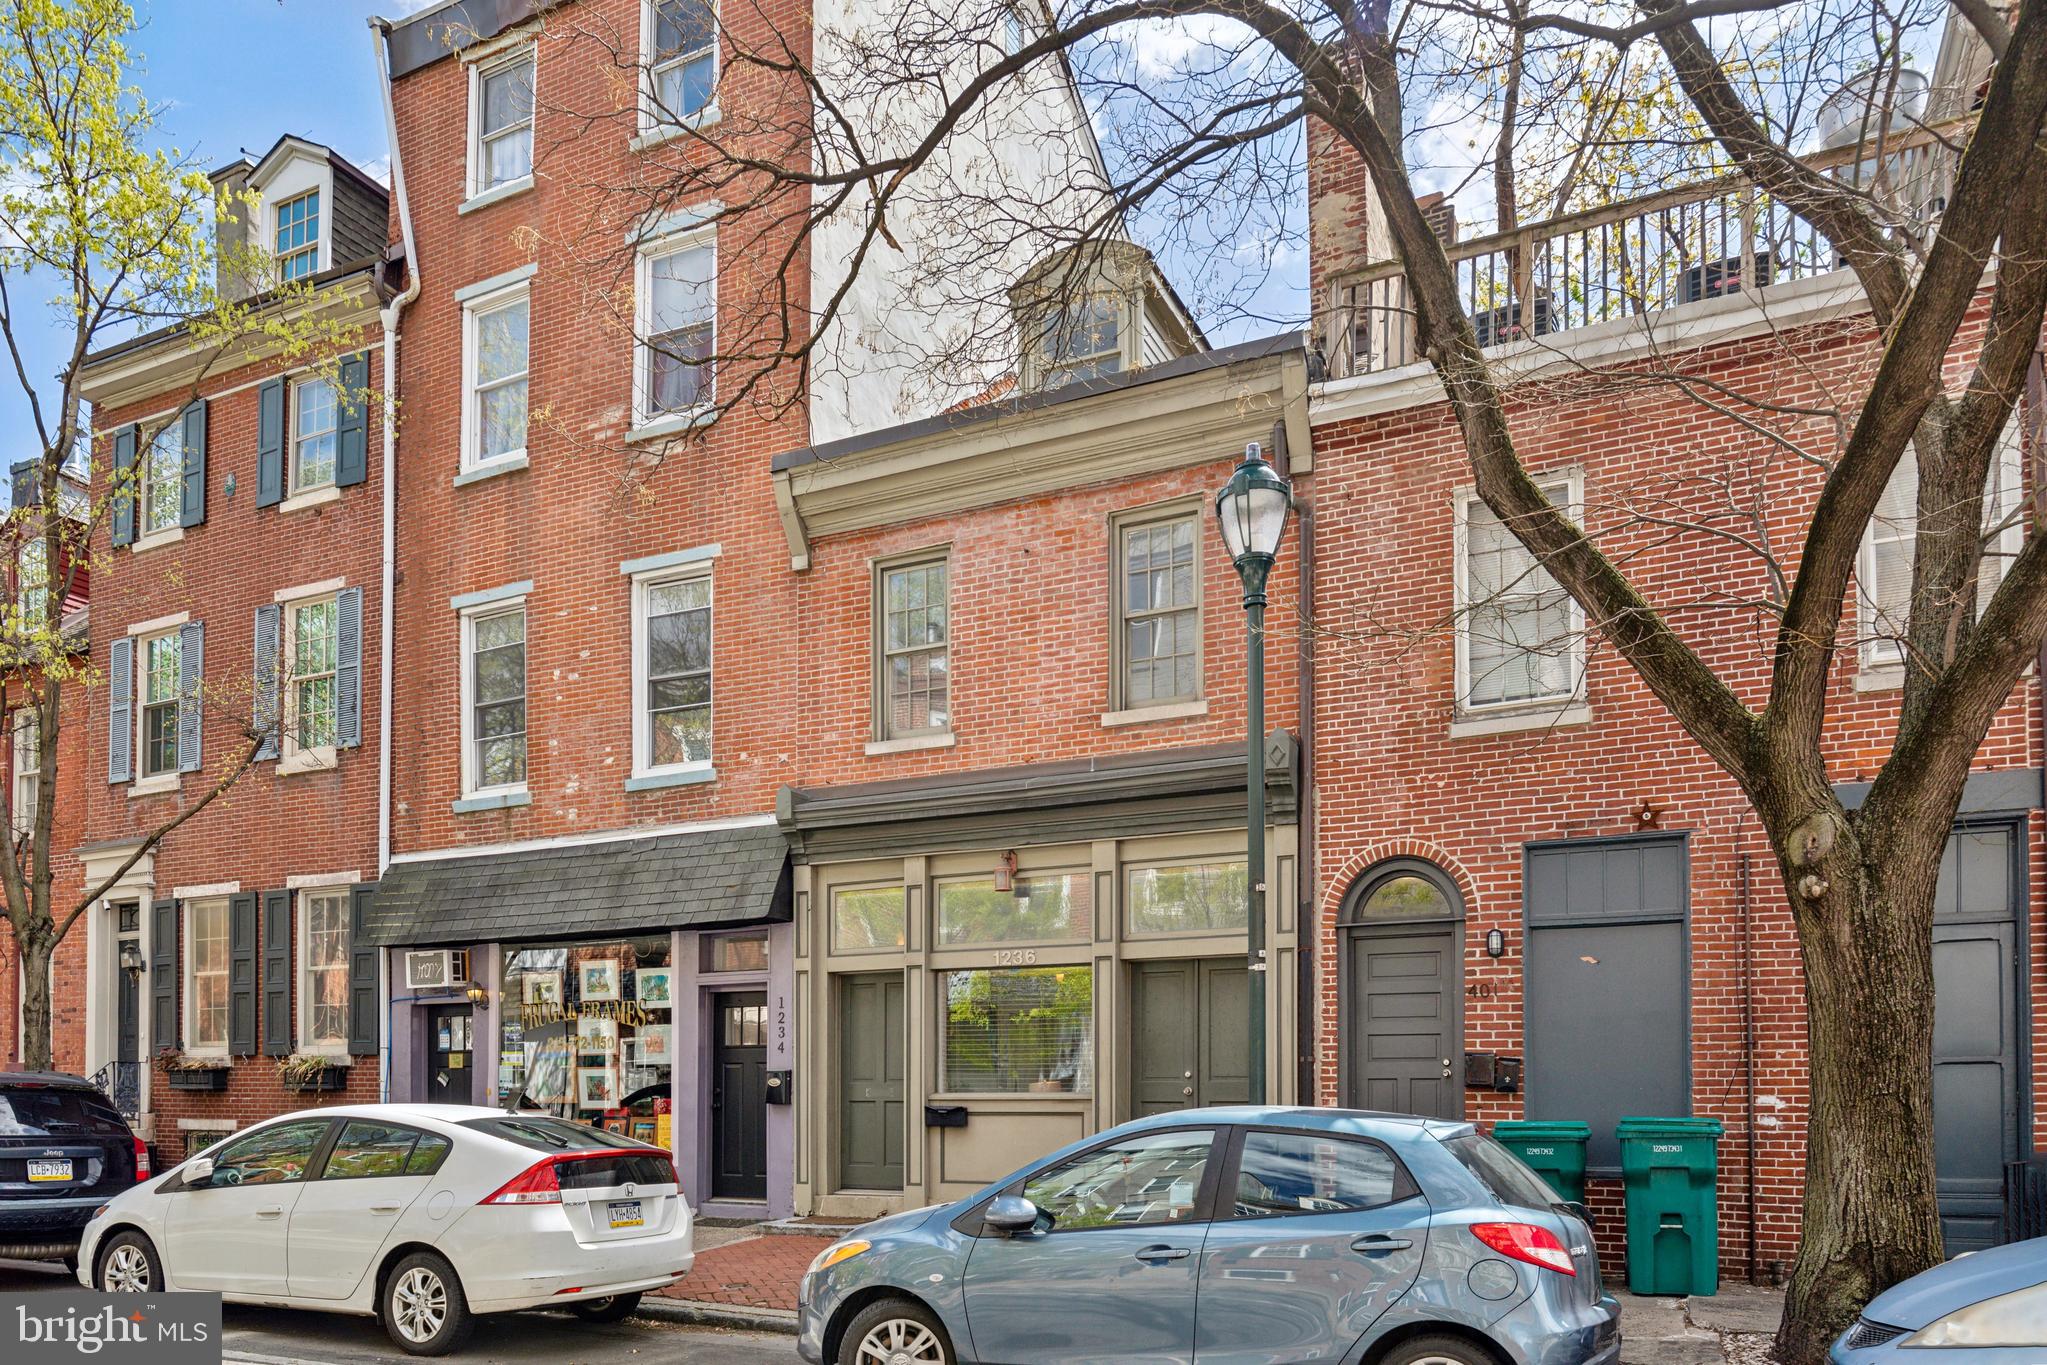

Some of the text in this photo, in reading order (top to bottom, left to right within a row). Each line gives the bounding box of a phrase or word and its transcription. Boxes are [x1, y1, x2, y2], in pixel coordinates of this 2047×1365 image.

[993, 950, 1036, 966] 1236
[1468, 983, 1498, 998] 401
[519, 998, 647, 1032] FRUGAL FRAMES
[777, 997, 786, 1053] 1234
[44, 1149, 64, 1157] Jeep
